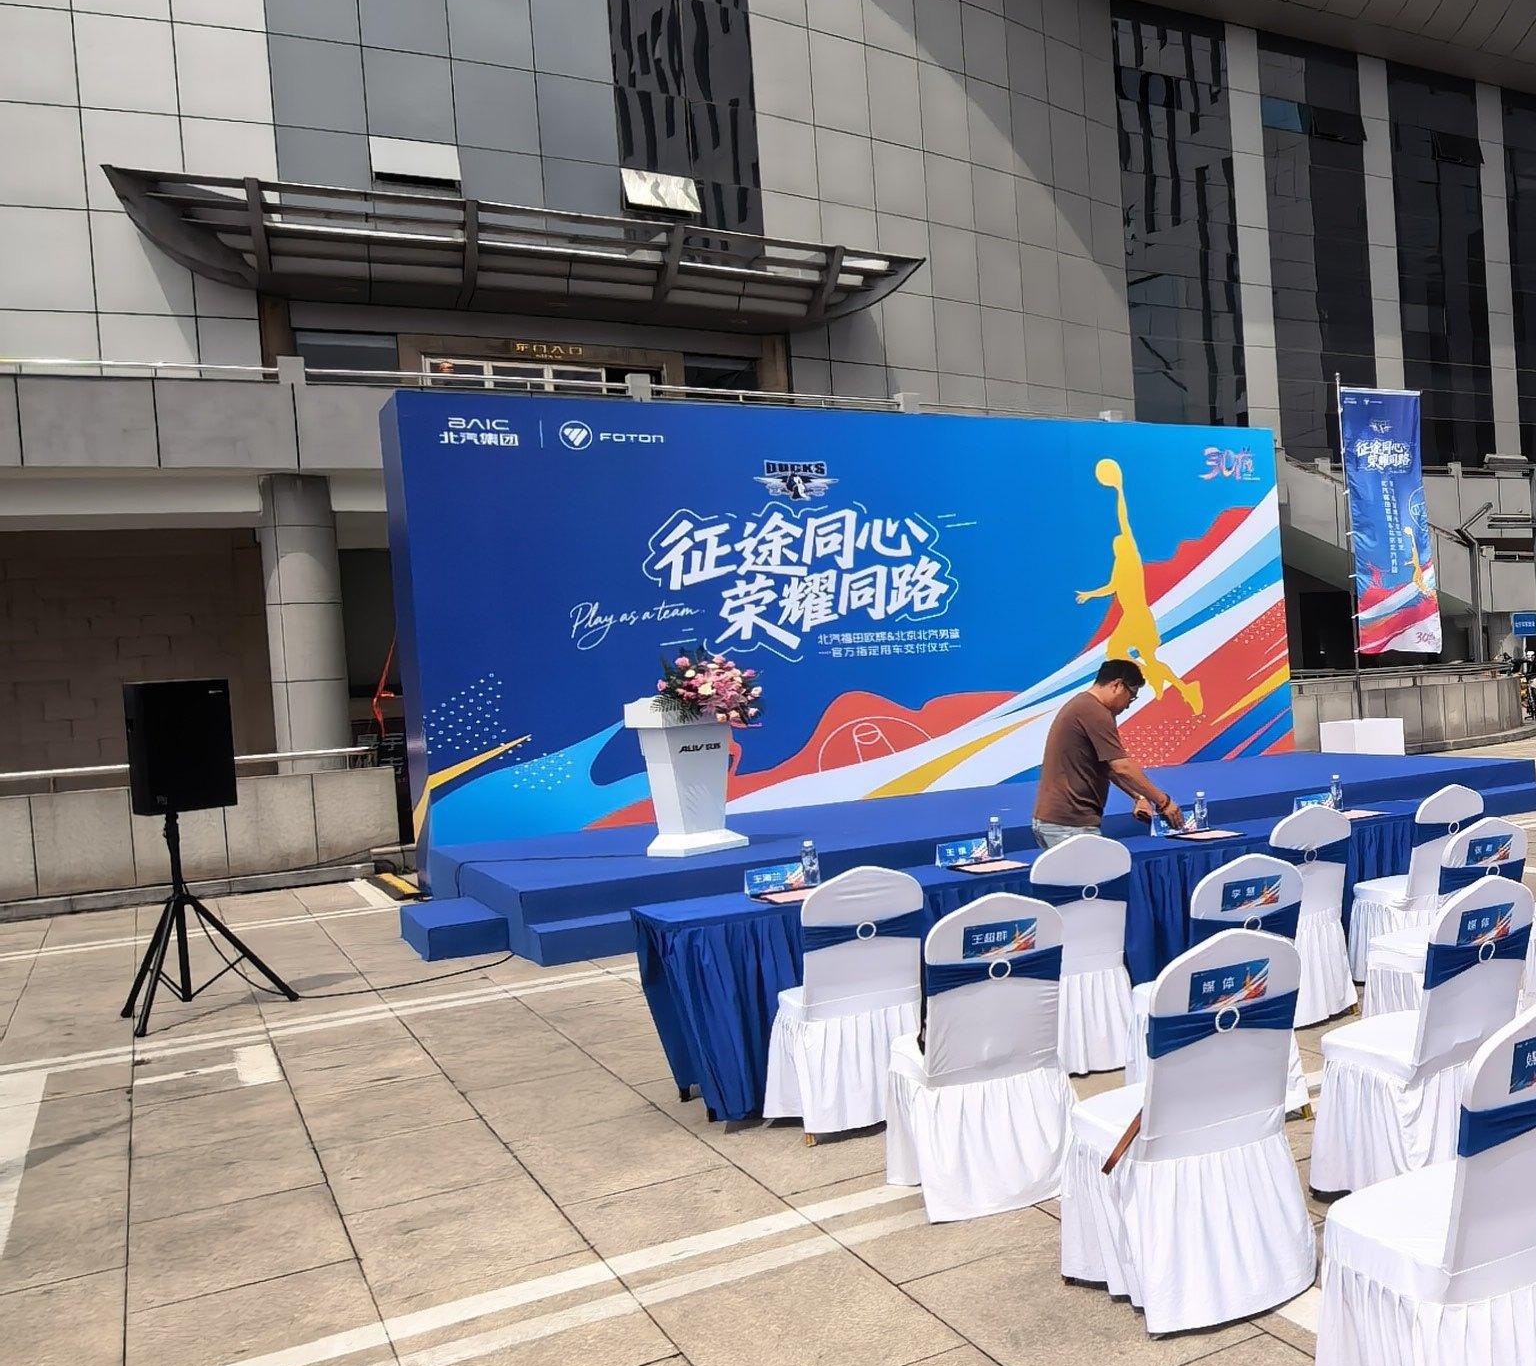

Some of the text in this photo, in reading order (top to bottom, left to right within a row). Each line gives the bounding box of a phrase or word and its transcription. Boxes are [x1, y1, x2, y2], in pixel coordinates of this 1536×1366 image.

[448, 417, 510, 431] BAIC
[439, 431, 519, 446] 北汽集团
[599, 432, 665, 444] FOTON
[765, 461, 826, 475] DUCKS
[654, 509, 929, 590] 征途同心
[715, 554, 950, 649] 荣耀同路
[570, 602, 617, 650] Play
[619, 611, 639, 625] as
[641, 611, 655, 621] a
[1202, 976, 1235, 995] 媒体
